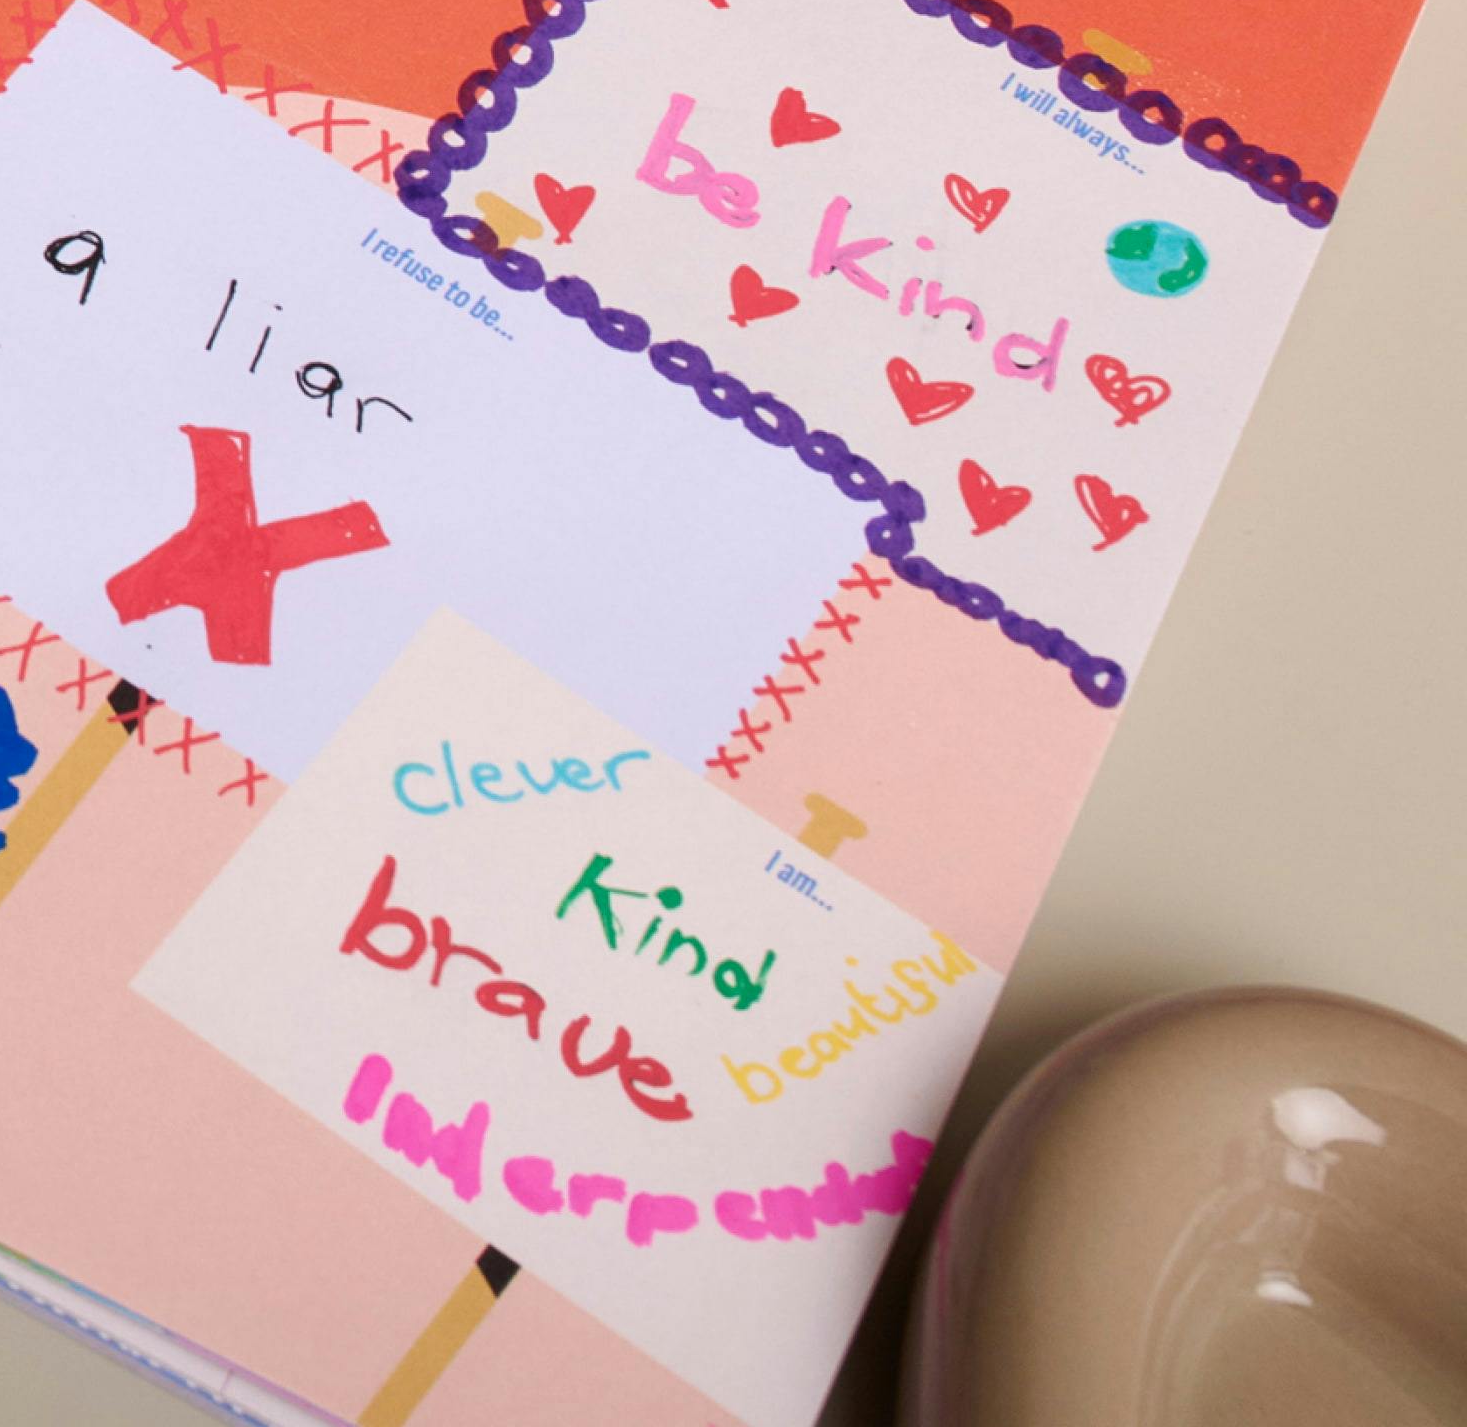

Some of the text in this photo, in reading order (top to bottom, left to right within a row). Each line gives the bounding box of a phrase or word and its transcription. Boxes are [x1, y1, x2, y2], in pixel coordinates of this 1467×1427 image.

[634, 92, 762, 231] be
[1000, 72, 1147, 175] I will always...
[43, 227, 414, 435] a liar
[361, 227, 515, 341] I refuse to be...
[392, 739, 653, 816] clever
[764, 849, 834, 912] I am...
[338, 853, 695, 1123] brave
